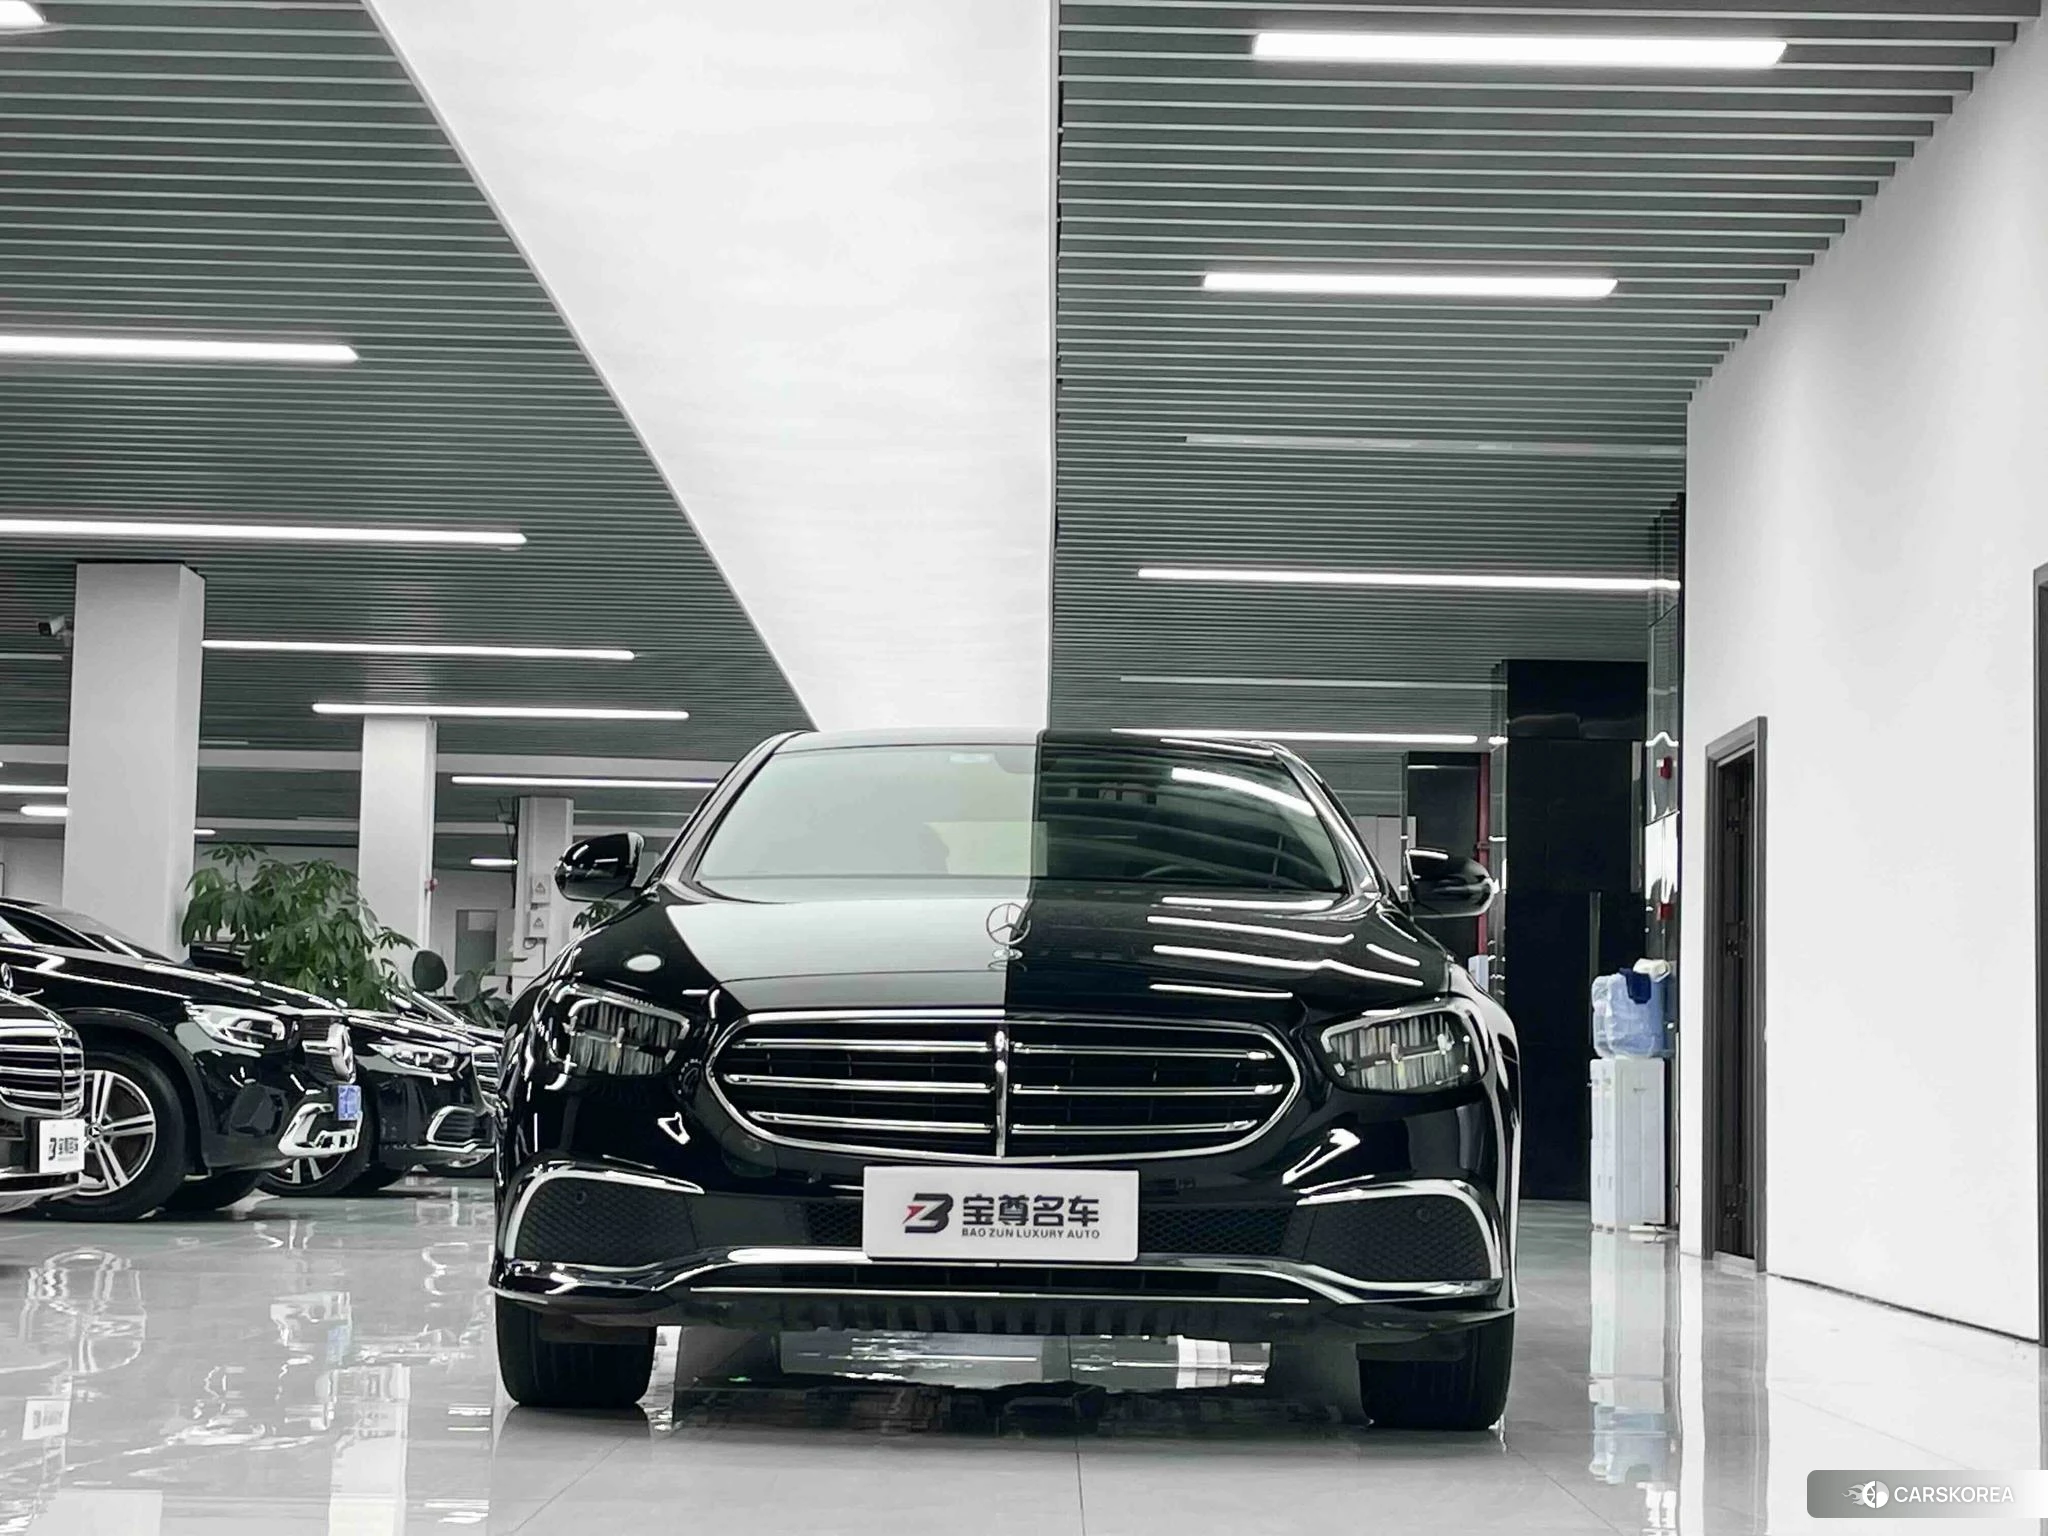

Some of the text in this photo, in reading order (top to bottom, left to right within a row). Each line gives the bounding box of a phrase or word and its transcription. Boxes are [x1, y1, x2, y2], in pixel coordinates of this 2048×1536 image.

[962, 1194, 1100, 1227] 宝尊名车
[961, 1227, 1100, 1240] BAO ZUN LUXURY AUTO
